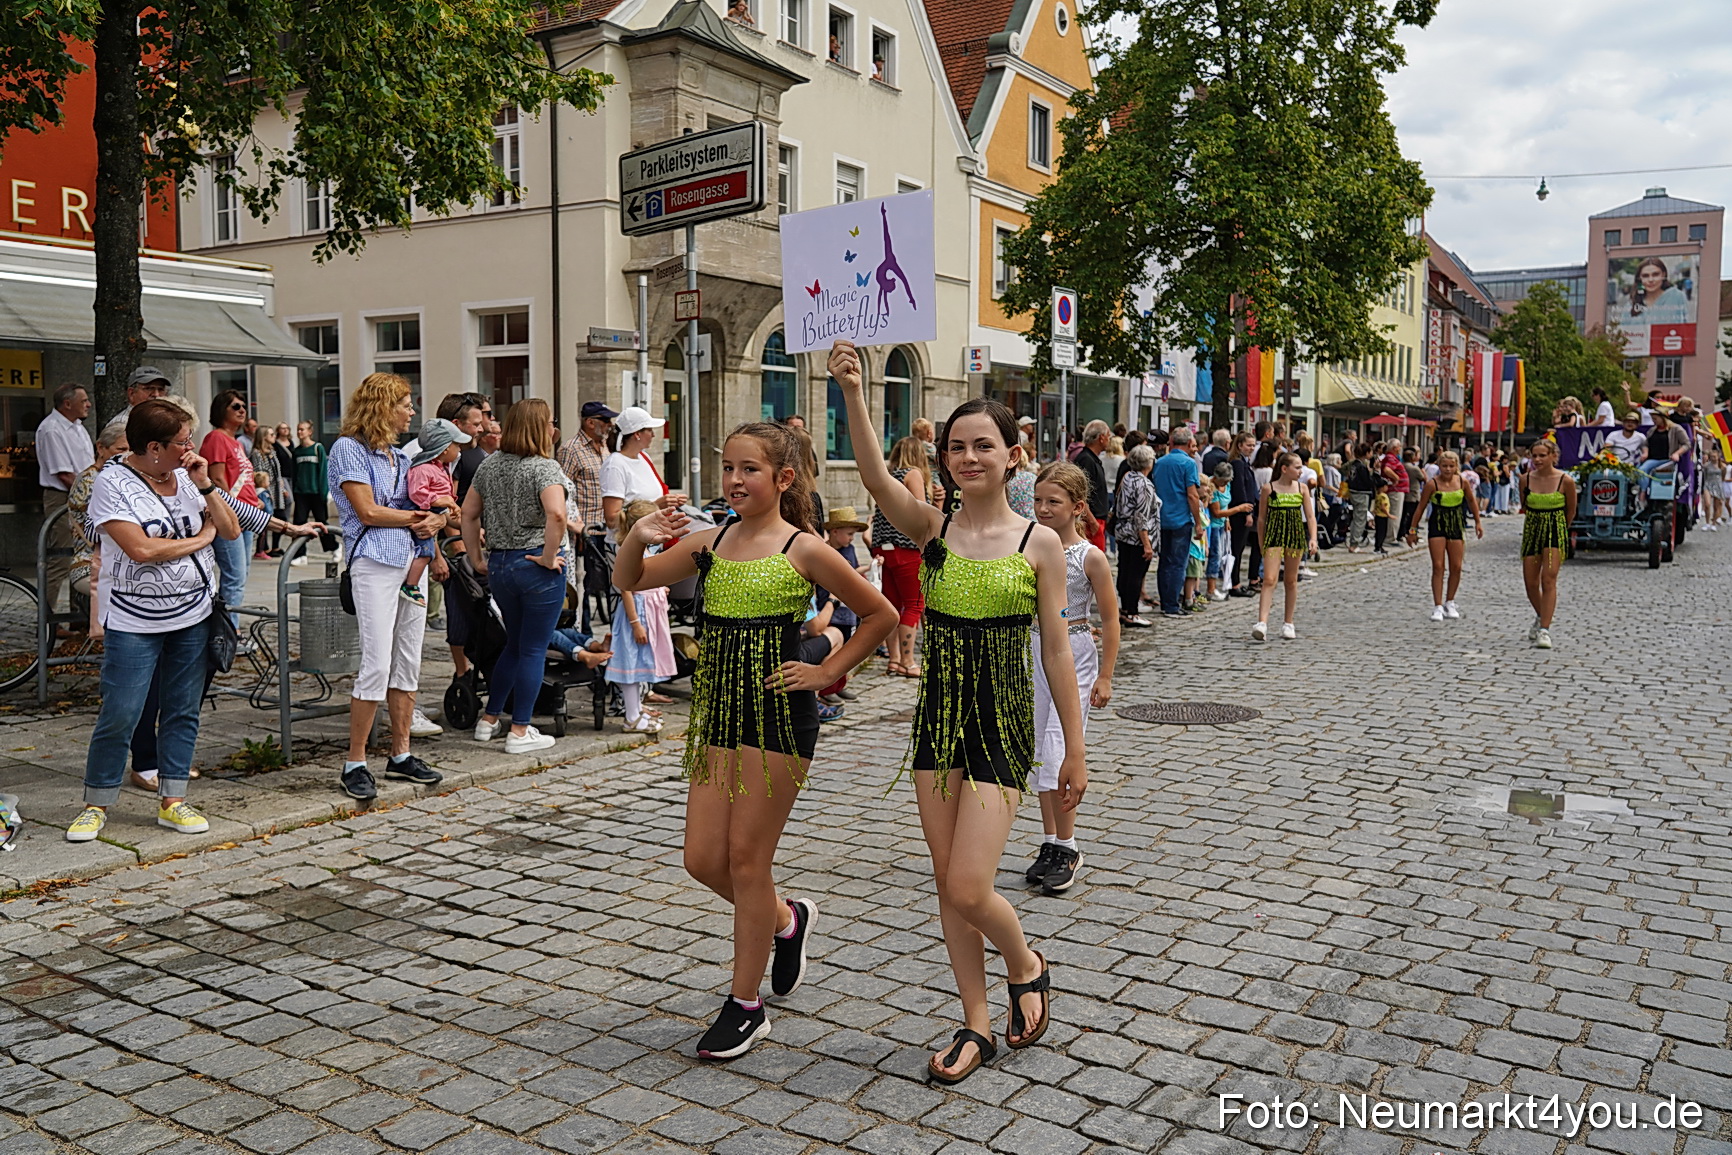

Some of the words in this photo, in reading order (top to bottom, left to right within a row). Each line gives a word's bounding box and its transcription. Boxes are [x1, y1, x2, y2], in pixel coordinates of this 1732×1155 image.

[640, 143, 728, 180] Parkleitsystem
[670, 182, 730, 208] Rosengasse
[814, 284, 858, 314] Magic
[802, 294, 890, 348] Butterflys
